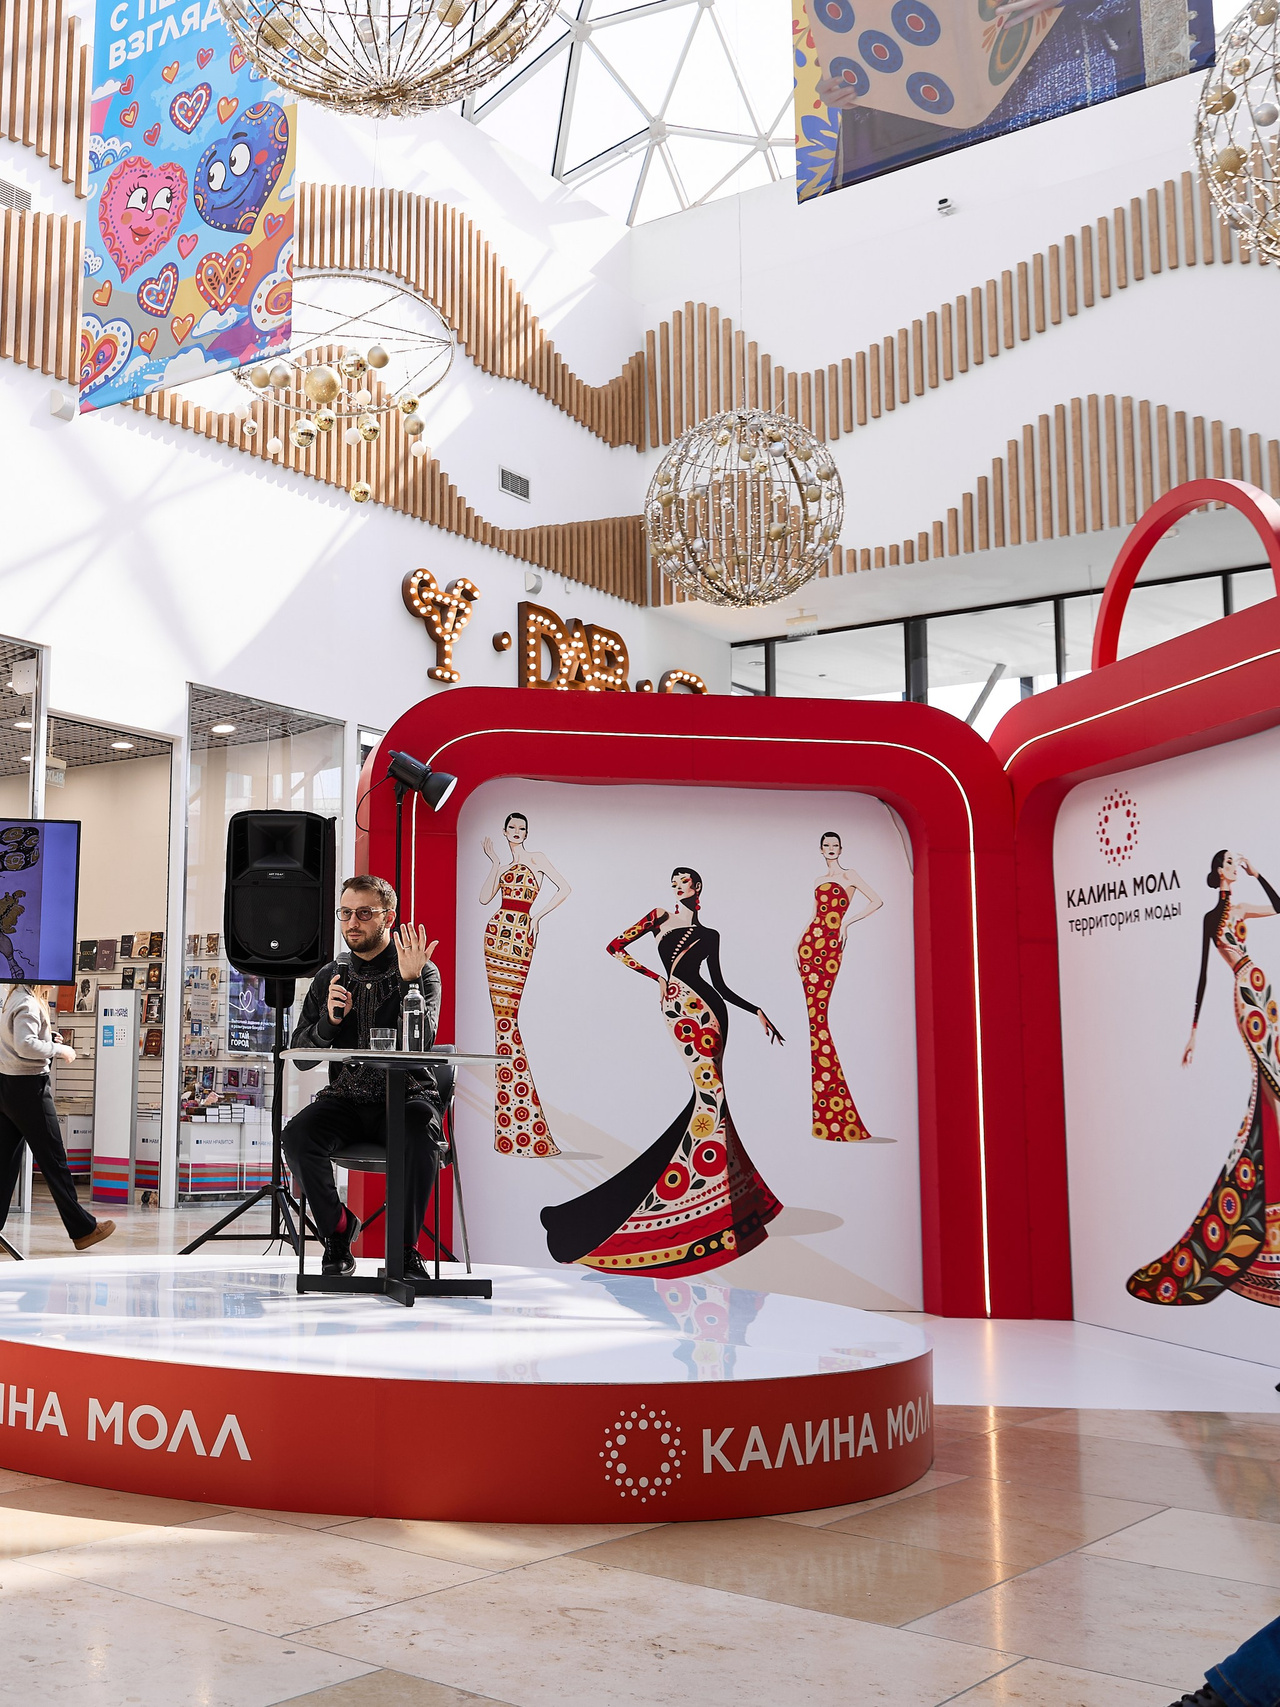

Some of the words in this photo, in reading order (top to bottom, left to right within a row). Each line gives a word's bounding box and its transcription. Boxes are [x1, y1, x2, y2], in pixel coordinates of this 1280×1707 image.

[110, 2, 129, 32] С
[1066, 879, 1128, 909] КАЛИНА
[1133, 869, 1181, 897] МОЛЛ
[1068, 908, 1141, 936] территория
[1144, 902, 1182, 922] моды
[230, 1039, 250, 1048] ГОРОД
[87, 1397, 252, 1461] МОЛЛ
[702, 1412, 878, 1474] КАЛИНА
[887, 1391, 931, 1450] МОЛЛ
